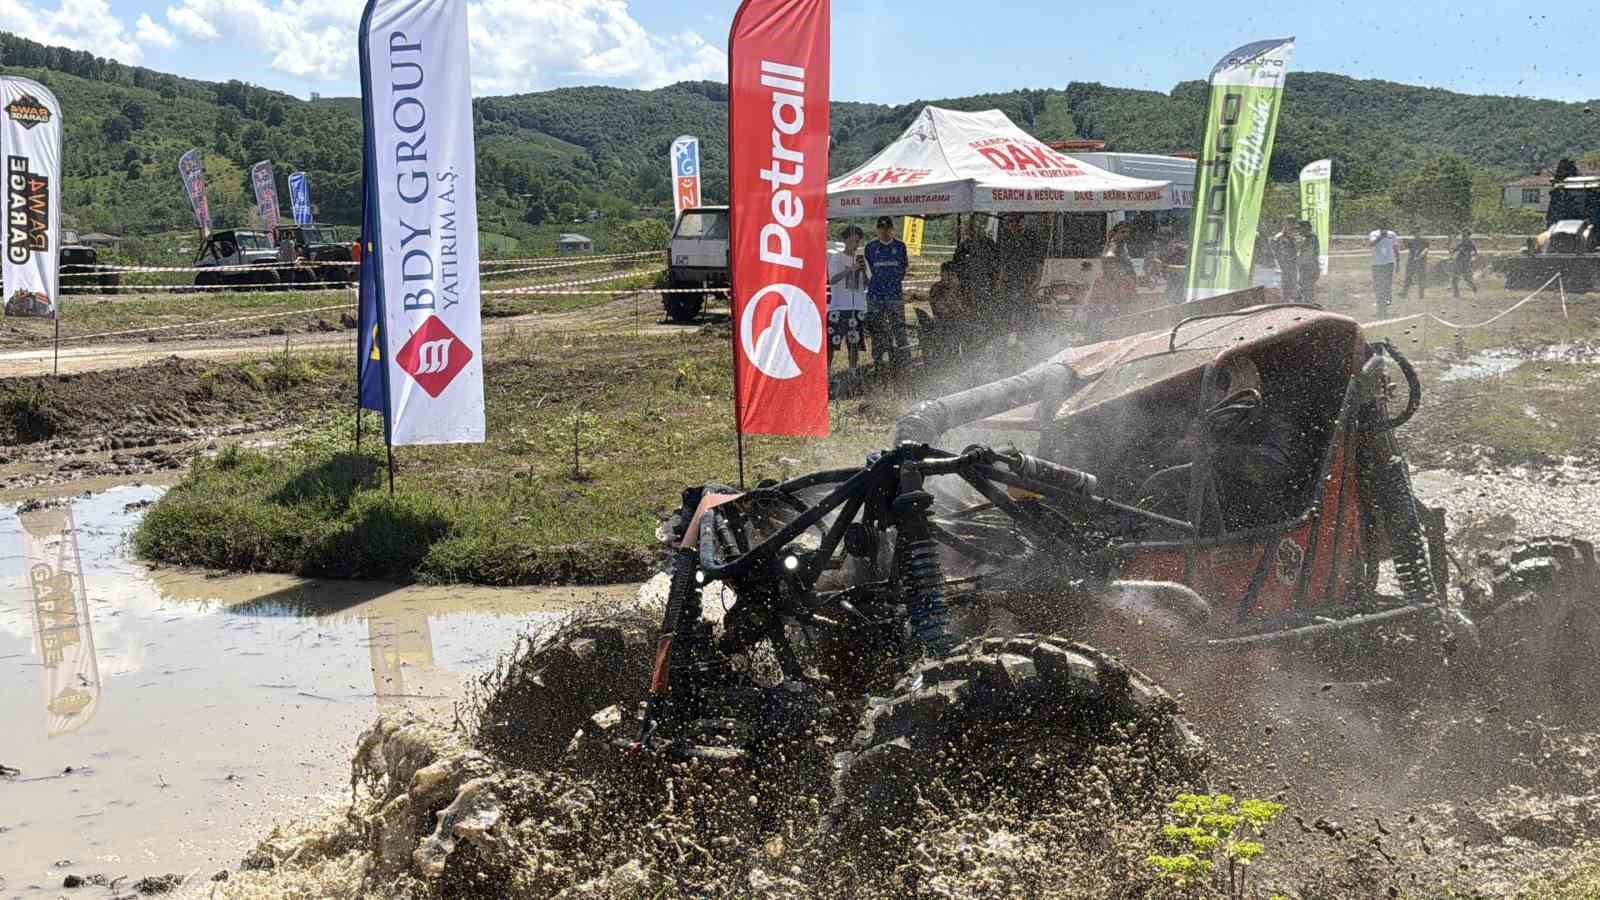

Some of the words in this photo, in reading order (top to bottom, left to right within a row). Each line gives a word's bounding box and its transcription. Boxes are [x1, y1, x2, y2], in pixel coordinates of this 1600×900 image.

[389, 31, 430, 205] GROUP
[437, 165, 459, 202] A.Ş.
[759, 60, 806, 270] Petrall
[976, 144, 1079, 171] DAKE
[992, 188, 1025, 201] SEARCH
[1034, 189, 1065, 201] RESCUE
[1073, 190, 1095, 201] DAKE
[1102, 190, 1127, 201] ARAMA
[1127, 190, 1163, 201] KURTARMA
[399, 218, 435, 313] BDY
[438, 208, 460, 310] YATIRIM
